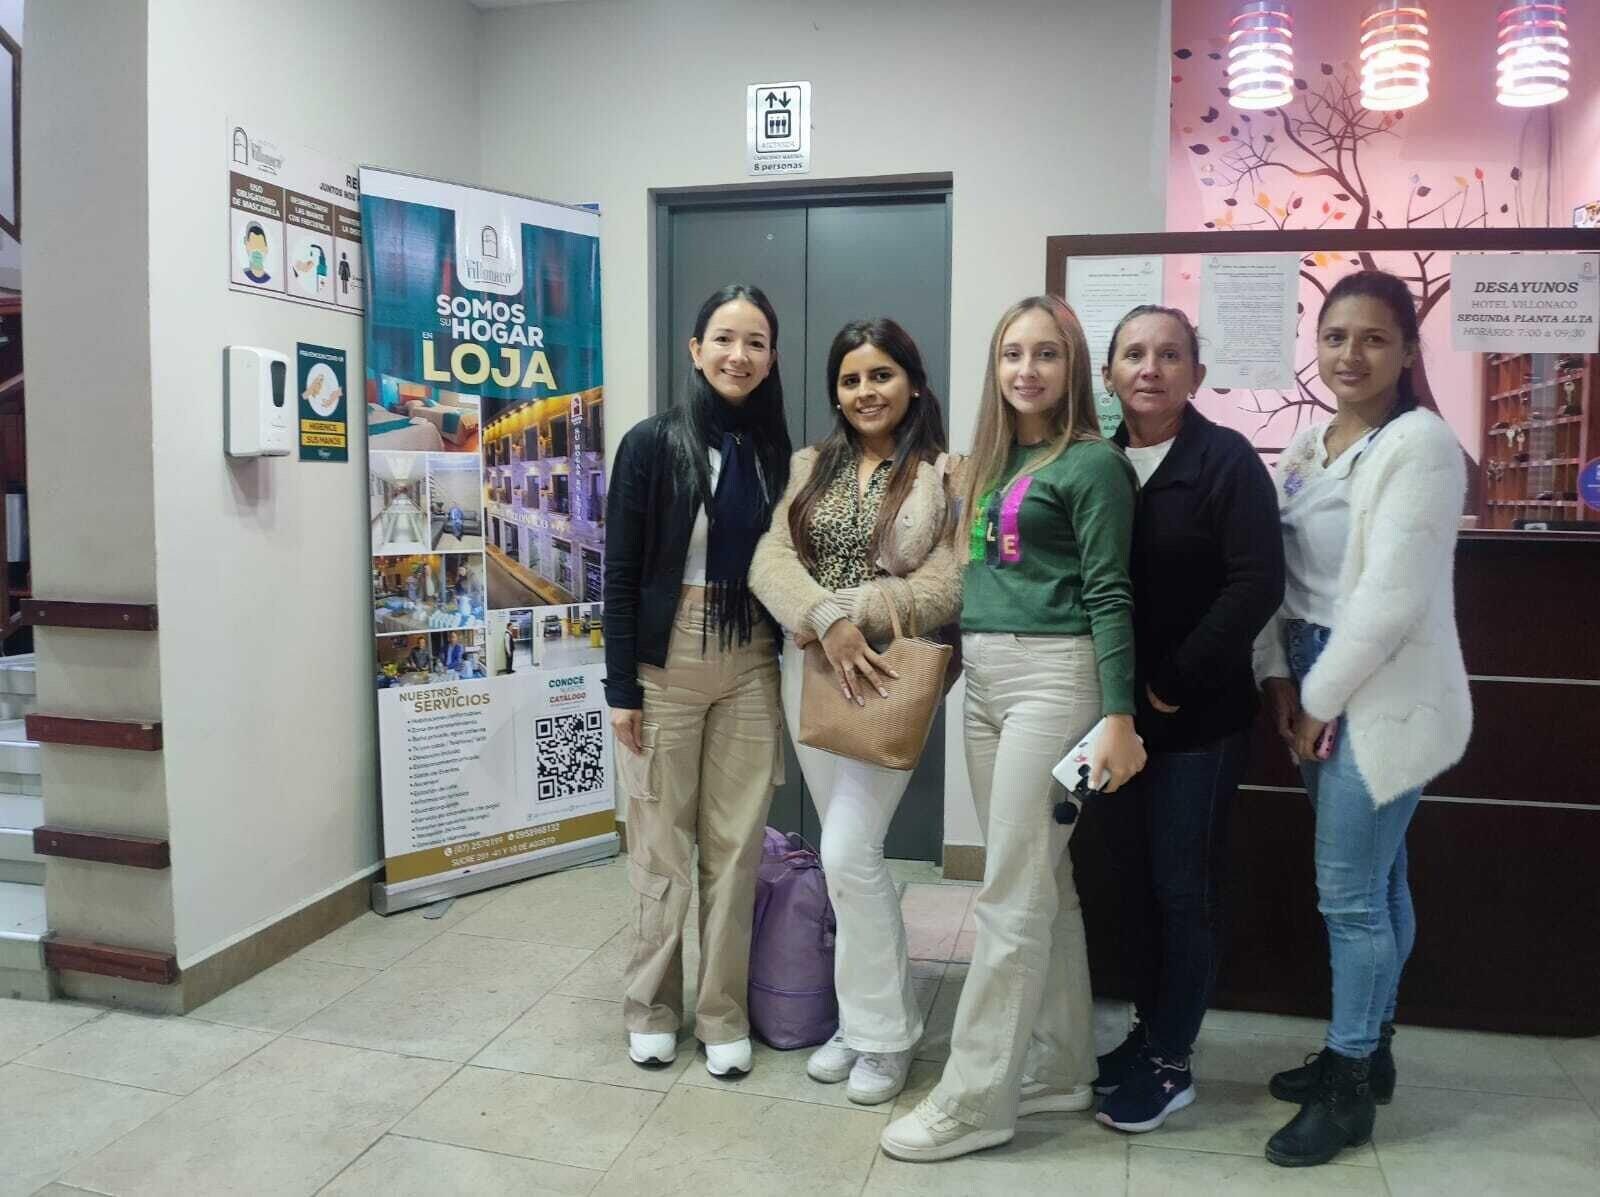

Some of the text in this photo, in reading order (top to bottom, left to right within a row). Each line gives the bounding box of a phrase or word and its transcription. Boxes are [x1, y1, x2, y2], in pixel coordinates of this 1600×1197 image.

[762, 162, 802, 171] personas
[1474, 281, 1579, 293] DESAYUNOS
[436, 294, 526, 324] SOMOS
[1472, 300, 1578, 309] HOTEL VILLONACO
[1457, 313, 1593, 323] SEGUNDA PLANTA ALTA
[422, 331, 433, 340] EN
[439, 317, 544, 348] SU HOGAR
[1463, 327, 1514, 337] HORARIO:
[1518, 328, 1542, 337] 7:00
[422, 339, 558, 390] LOJA
[549, 675, 585, 688] CONOCE
[399, 686, 459, 702] NUESTROS
[414, 693, 490, 713] SERVICIOS
